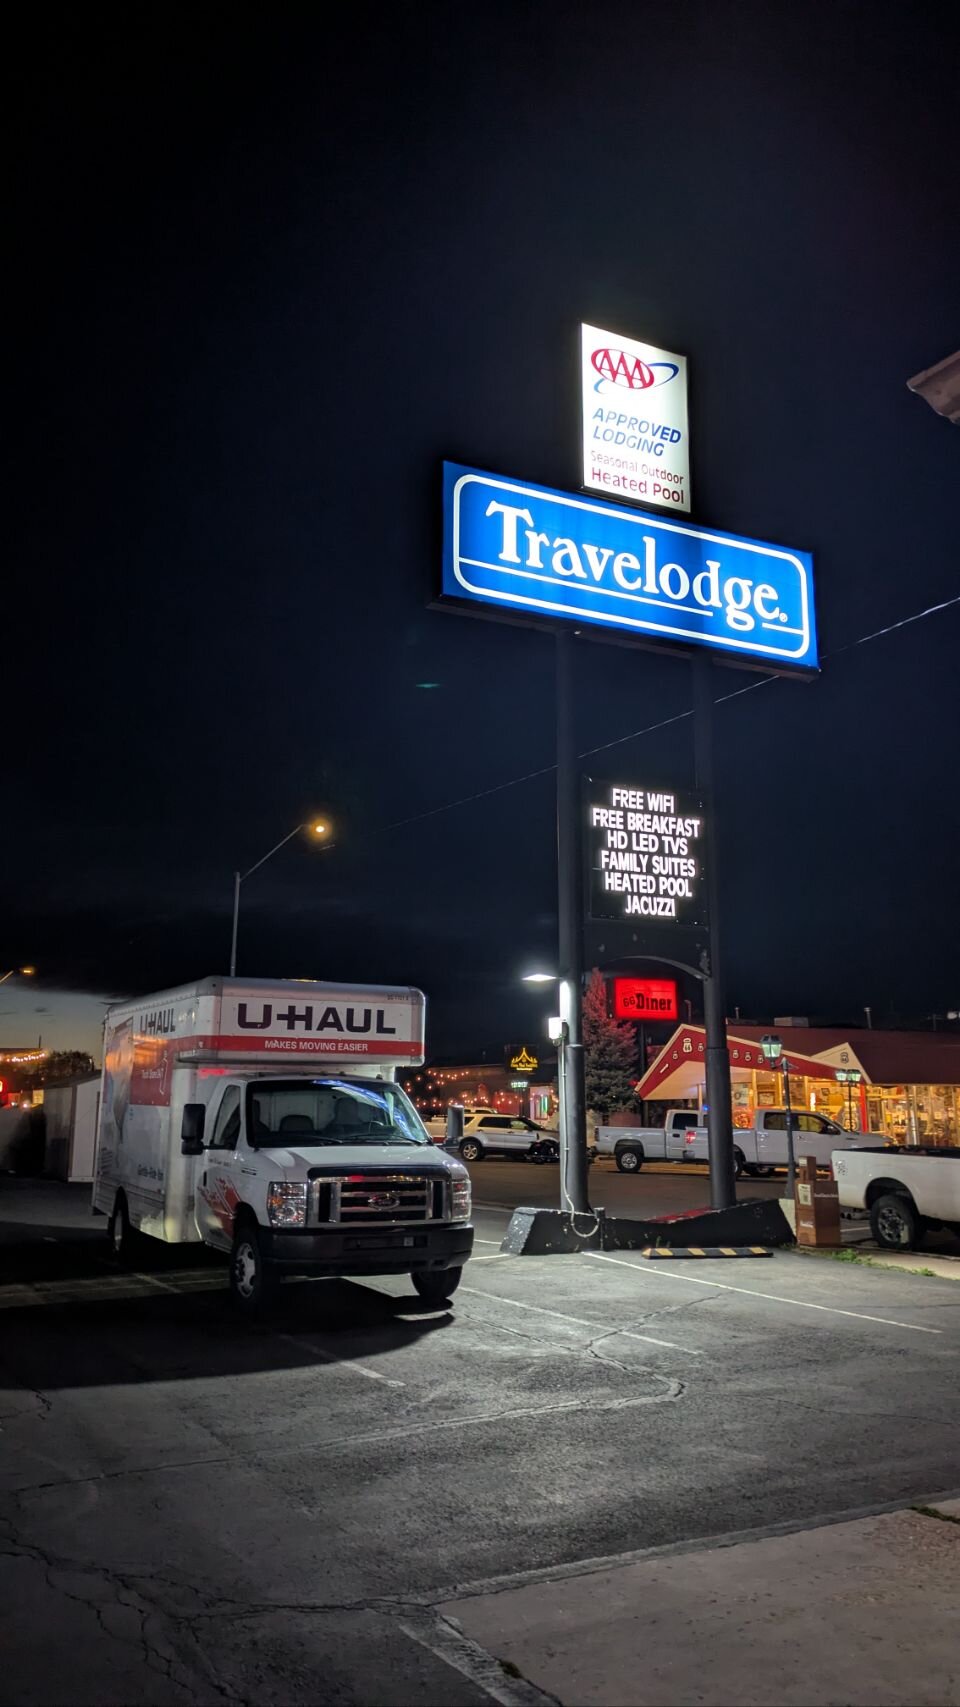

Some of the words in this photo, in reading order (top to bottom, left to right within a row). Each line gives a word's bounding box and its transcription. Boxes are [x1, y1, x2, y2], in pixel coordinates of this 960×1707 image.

[595, 349, 651, 389] AAA
[592, 408, 682, 443] APPROVED
[593, 425, 665, 457] LODGING
[591, 450, 638, 472] Seasonal
[641, 463, 684, 485] Outdoor
[592, 467, 648, 494] Heated
[653, 483, 684, 504] Pool
[612, 788, 644, 809] FREE
[647, 792, 675, 814] WIFI
[592, 808, 624, 830] FREE
[627, 812, 701, 838] BREAKFAST
[607, 830, 629, 849] HD
[632, 832, 659, 852] LED
[662, 836, 688, 856] TVS
[601, 850, 648, 873] FAMILY
[652, 855, 696, 877] SUITES
[605, 871, 656, 894] HEATED
[659, 877, 692, 897] POOL
[625, 895, 676, 917] JACUZZI
[622, 995, 636, 1007] 66
[636, 993, 673, 1011] Diner
[140, 1008, 176, 1035] U-HAUL
[237, 1002, 396, 1034] U-HAUL
[264, 1039, 297, 1050] MAKES
[299, 1041, 336, 1051] MOVING
[337, 1042, 369, 1052] EASIER
